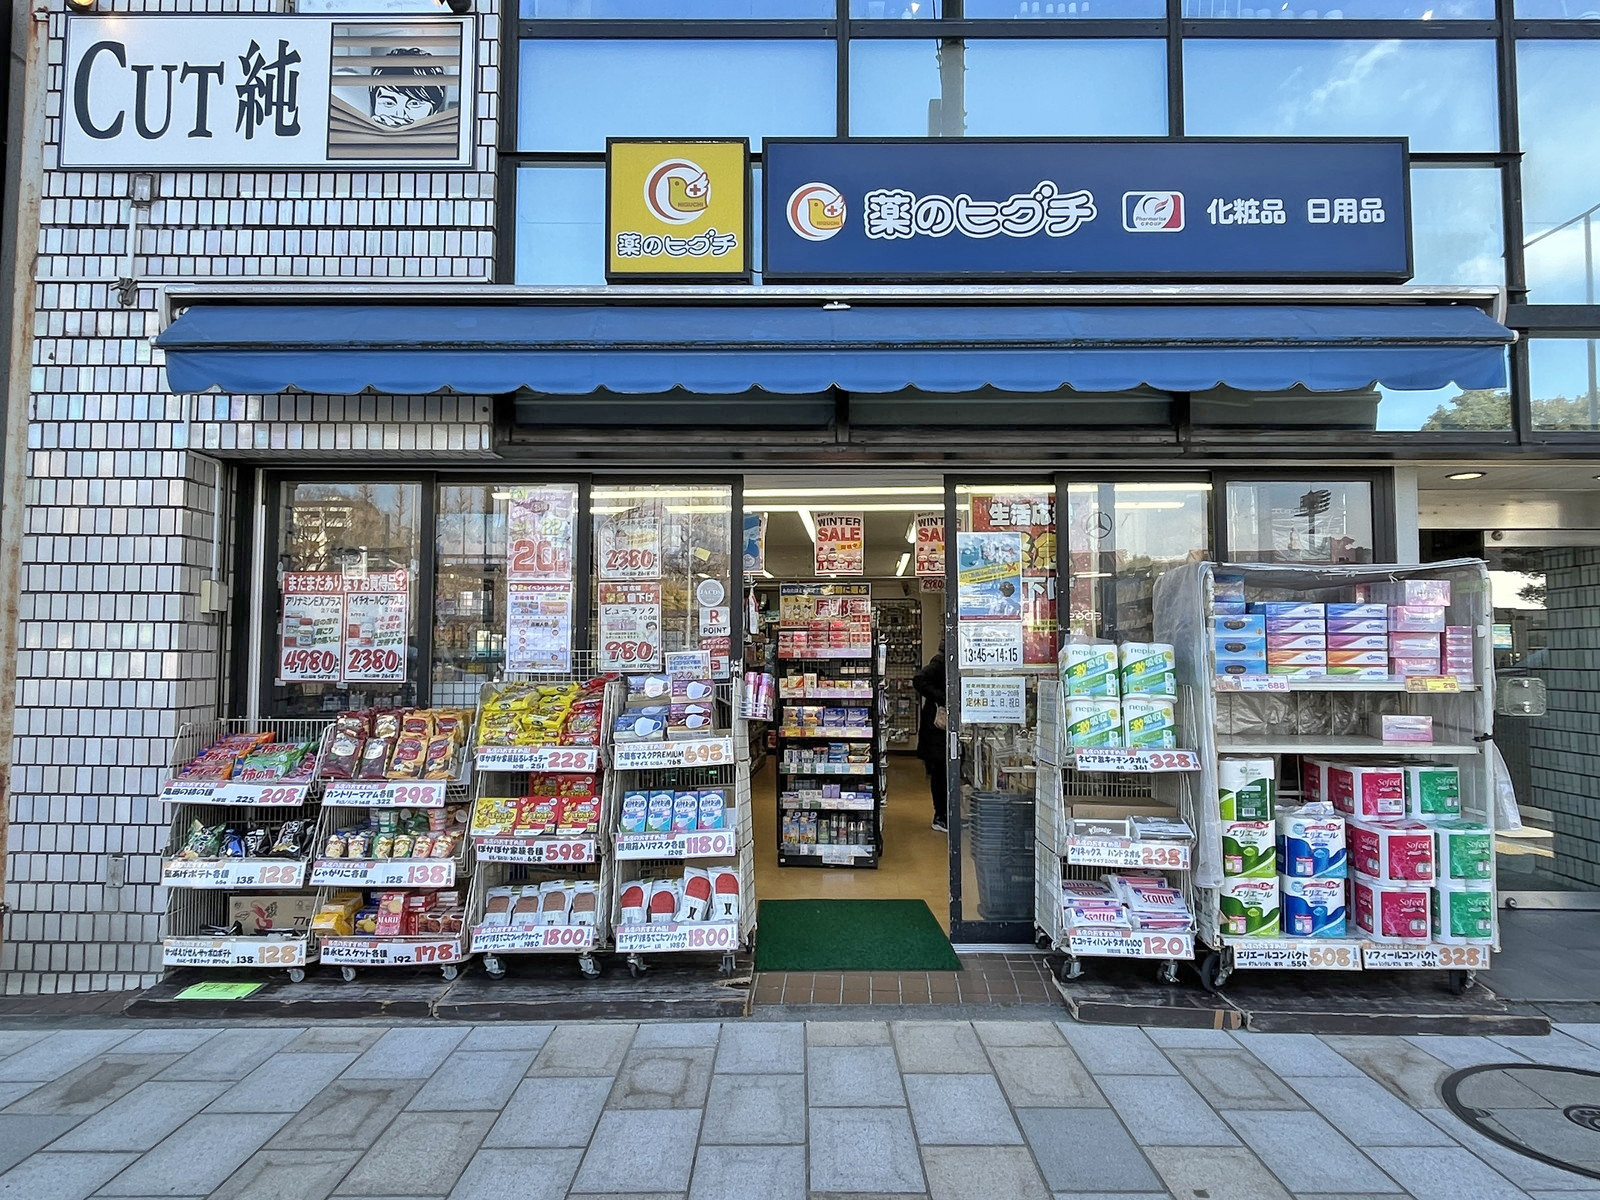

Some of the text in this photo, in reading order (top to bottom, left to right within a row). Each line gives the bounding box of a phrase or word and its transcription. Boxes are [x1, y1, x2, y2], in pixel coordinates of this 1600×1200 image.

[864, 180, 1098, 239] 薬のヒグチ
[1207, 198, 1385, 225] 化粧品 日用品
[617, 228, 738, 258] 薬のヒグチ
[817, 516, 861, 527] WINTER
[817, 527, 861, 542] SALE
[605, 549, 653, 571] 2380
[286, 596, 342, 607] アリナミンEXプラス
[604, 607, 656, 616] ビューラック
[709, 609, 720, 625] R
[703, 627, 727, 635] POINT
[605, 641, 653, 662] 980
[964, 647, 1018, 663] 13:45～14:15
[1072, 648, 1097, 656] nepia
[1130, 647, 1156, 656] nepia
[283, 648, 336, 674] 4980
[347, 648, 399, 673] 2380
[965, 697, 989, 708] 定休日
[1075, 705, 1101, 713] nepia
[1129, 704, 1155, 712] nepia
[548, 751, 589, 769] 228
[1149, 753, 1191, 769] 328
[235, 795, 255, 803] 225
[259, 787, 300, 803] 208
[394, 786, 437, 804] 298
[1230, 829, 1268, 838] エリエール
[1302, 830, 1339, 839] エリエール
[545, 843, 587, 861] 598
[686, 835, 727, 854] 1180
[1141, 847, 1182, 866] 238
[235, 876, 255, 884] 138
[258, 865, 298, 884] 128
[314, 868, 369, 879] じゃがりこ各種
[385, 876, 404, 884] 128
[407, 864, 446, 884] 138
[1235, 890, 1273, 899] エリエール
[1301, 889, 1338, 898] エリエール
[543, 928, 585, 946] 1800
[688, 928, 729, 947] 1800
[414, 944, 454, 963] 178
[1143, 936, 1184, 956] 120
[236, 955, 254, 964] 138
[258, 945, 298, 965] 128
[393, 955, 411, 964] 192
[1236, 951, 1309, 961] エリエールコンパクト
[1309, 947, 1351, 966] 508
[1438, 947, 1481, 966] 328
